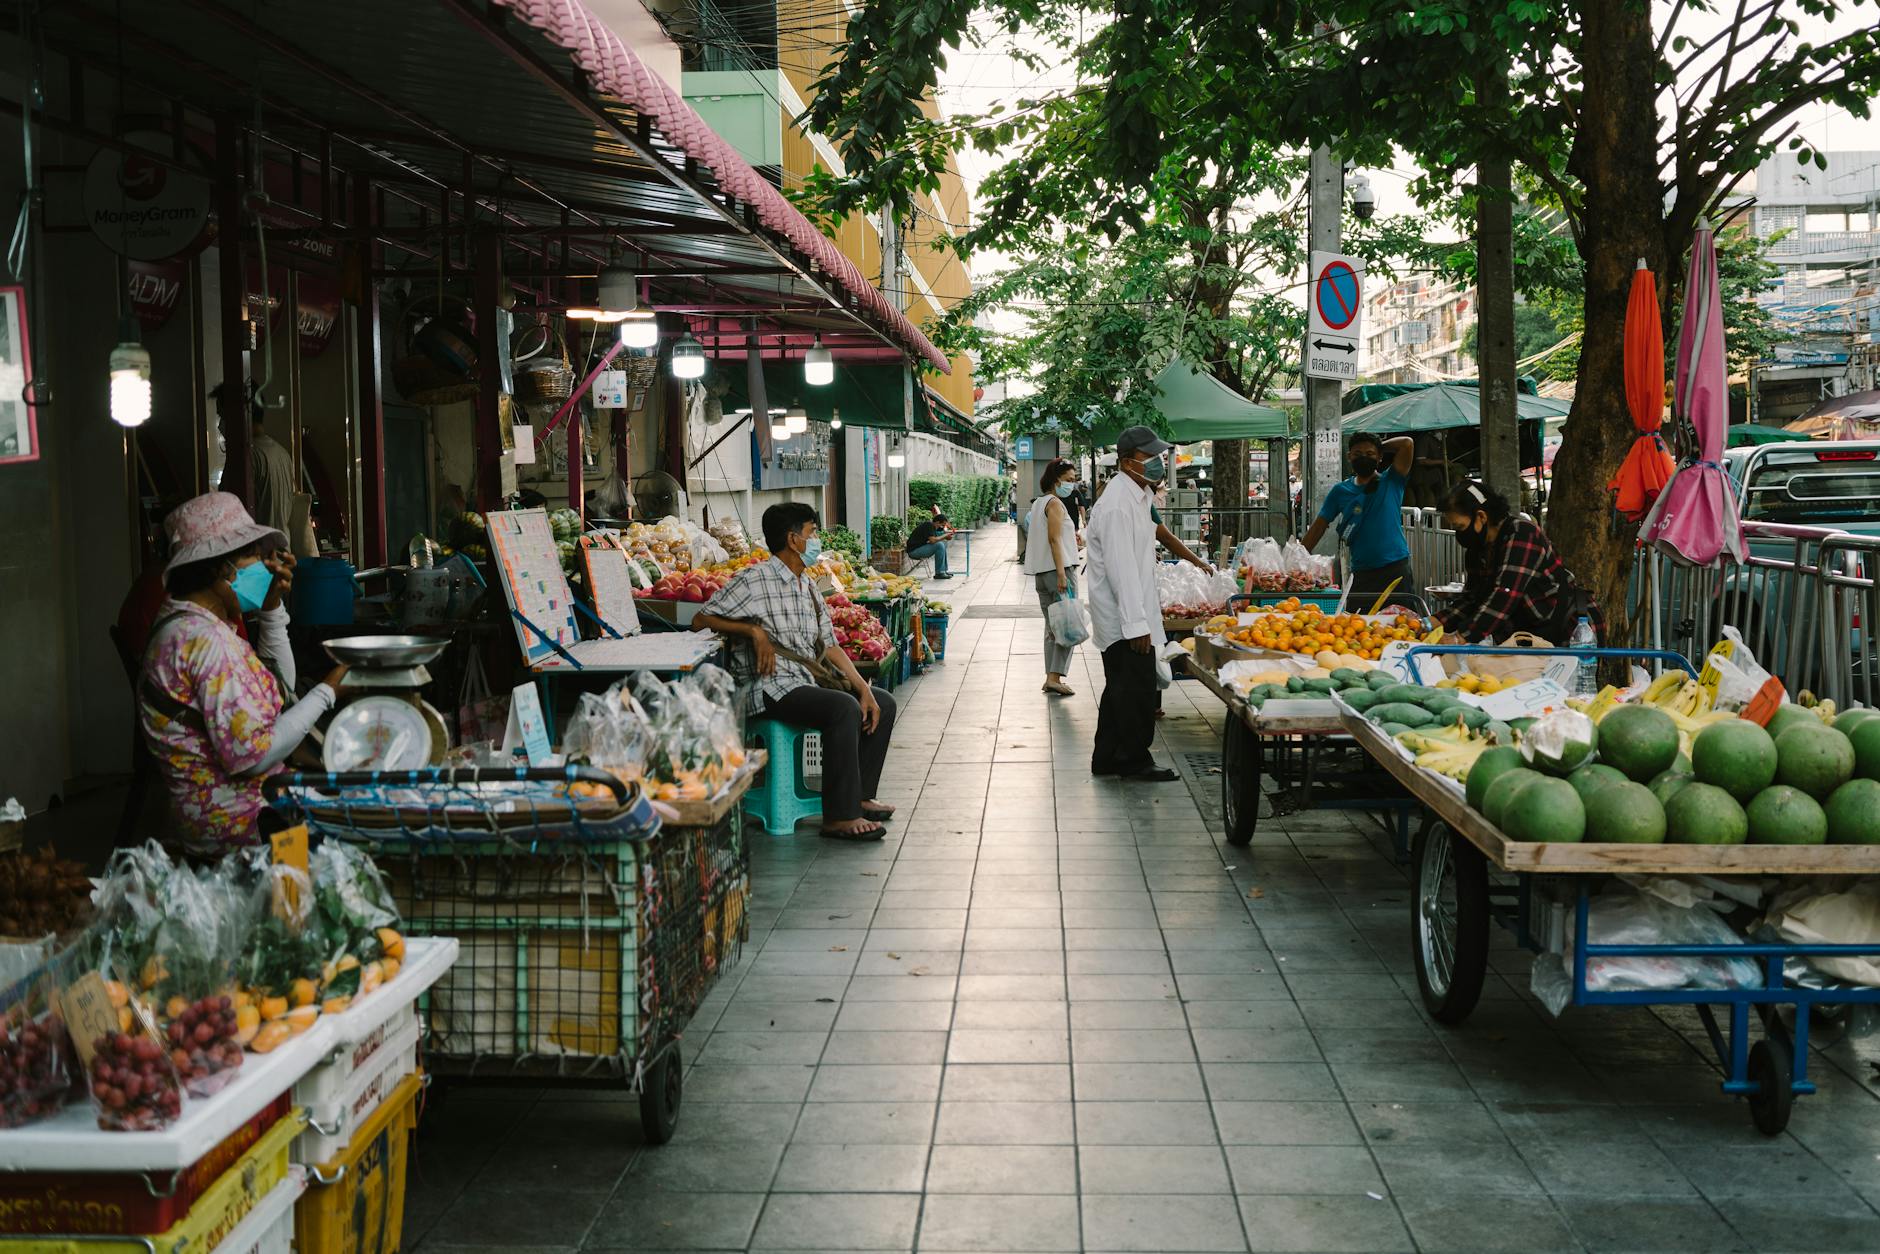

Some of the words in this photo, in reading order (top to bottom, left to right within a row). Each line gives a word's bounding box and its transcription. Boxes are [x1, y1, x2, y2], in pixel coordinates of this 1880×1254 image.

[95, 206, 195, 225] MoneyGram
[303, 238, 334, 257] ZONE
[128, 271, 180, 309] ADM
[297, 312, 335, 340] ADM
[1311, 358, 1355, 375] ตลอดเวลา
